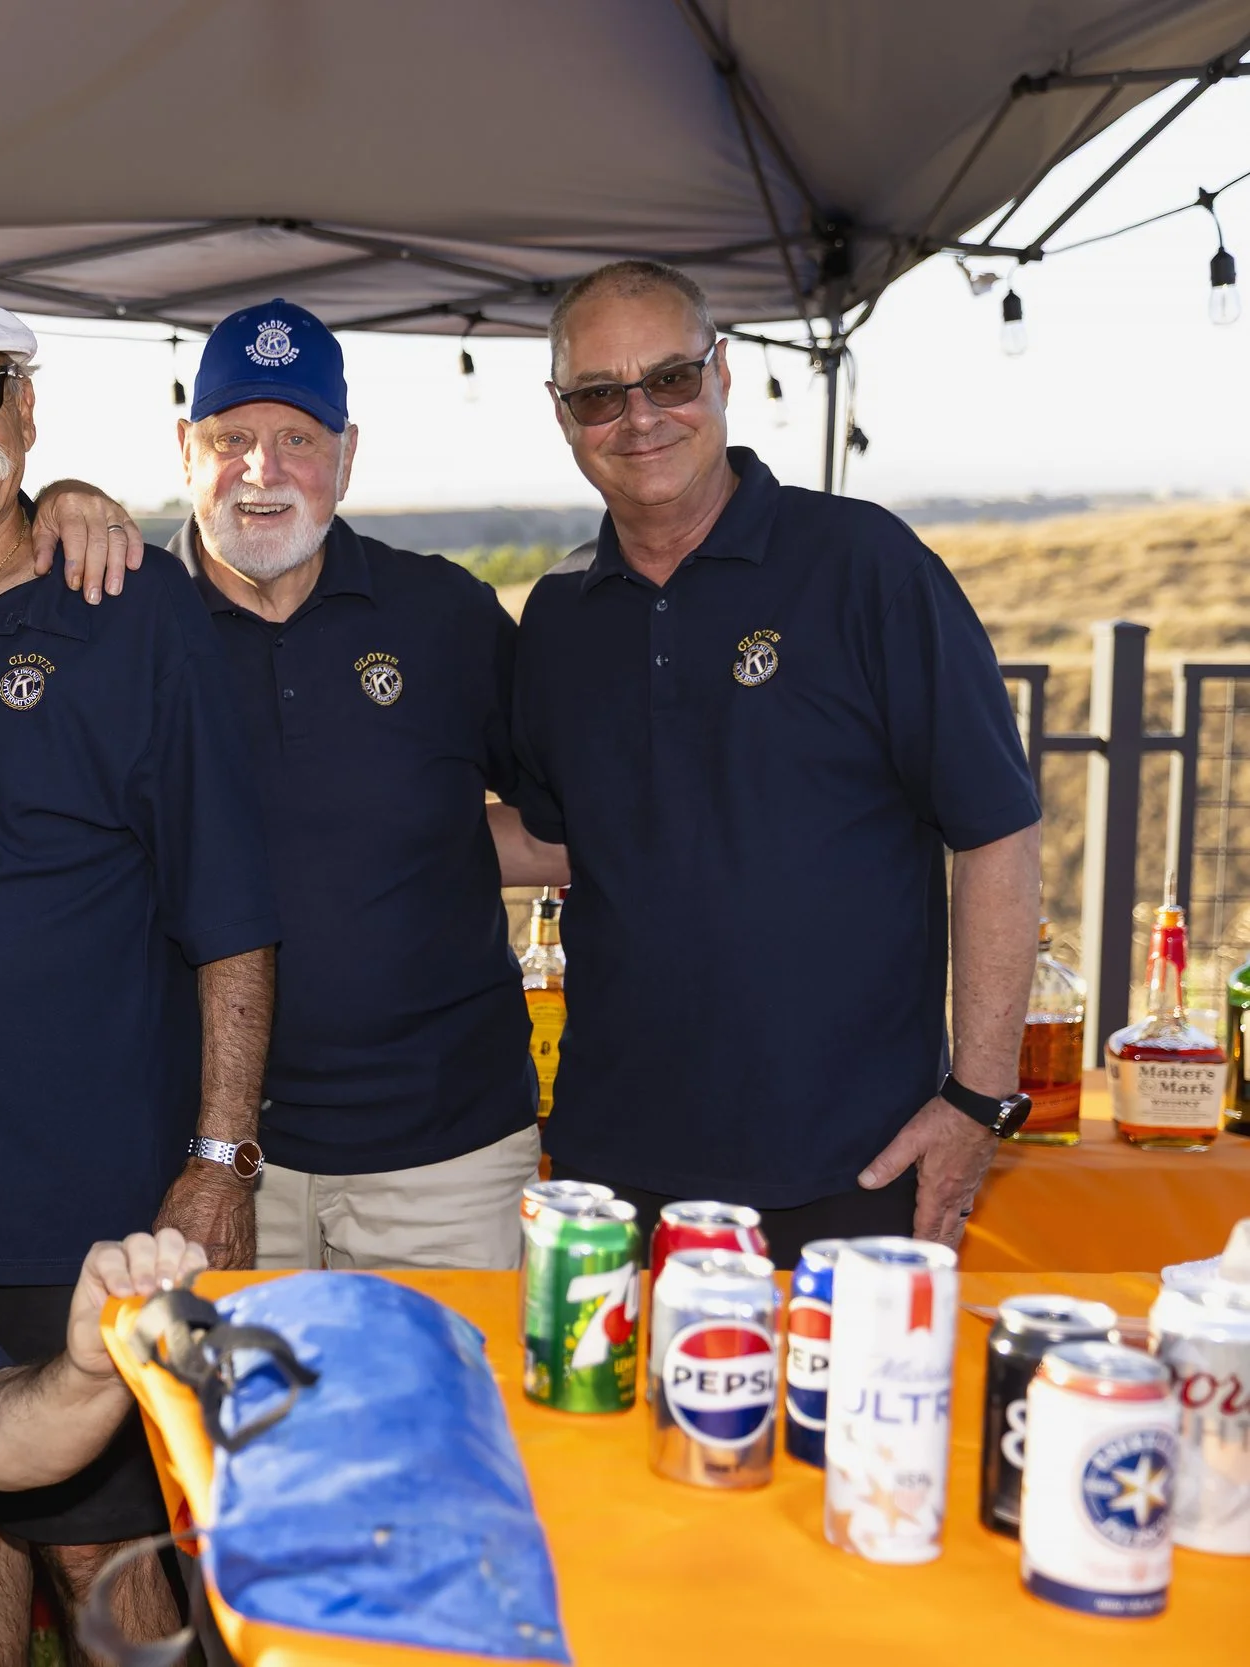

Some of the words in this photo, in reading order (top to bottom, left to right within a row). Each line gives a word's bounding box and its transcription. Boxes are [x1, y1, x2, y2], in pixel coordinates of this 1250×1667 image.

[257, 320, 292, 334] CLOVIS
[281, 347, 300, 365] CLUB
[8, 653, 56, 674] CLOVIS
[354, 652, 399, 672] CLOVIS
[745, 650, 765, 676] K
[11, 674, 34, 699] K
[371, 673, 392, 696] K
[1138, 1065, 1216, 1080] Maker's
[1159, 1081, 1214, 1096] Mark
[673, 1365, 774, 1396] PEPSI
